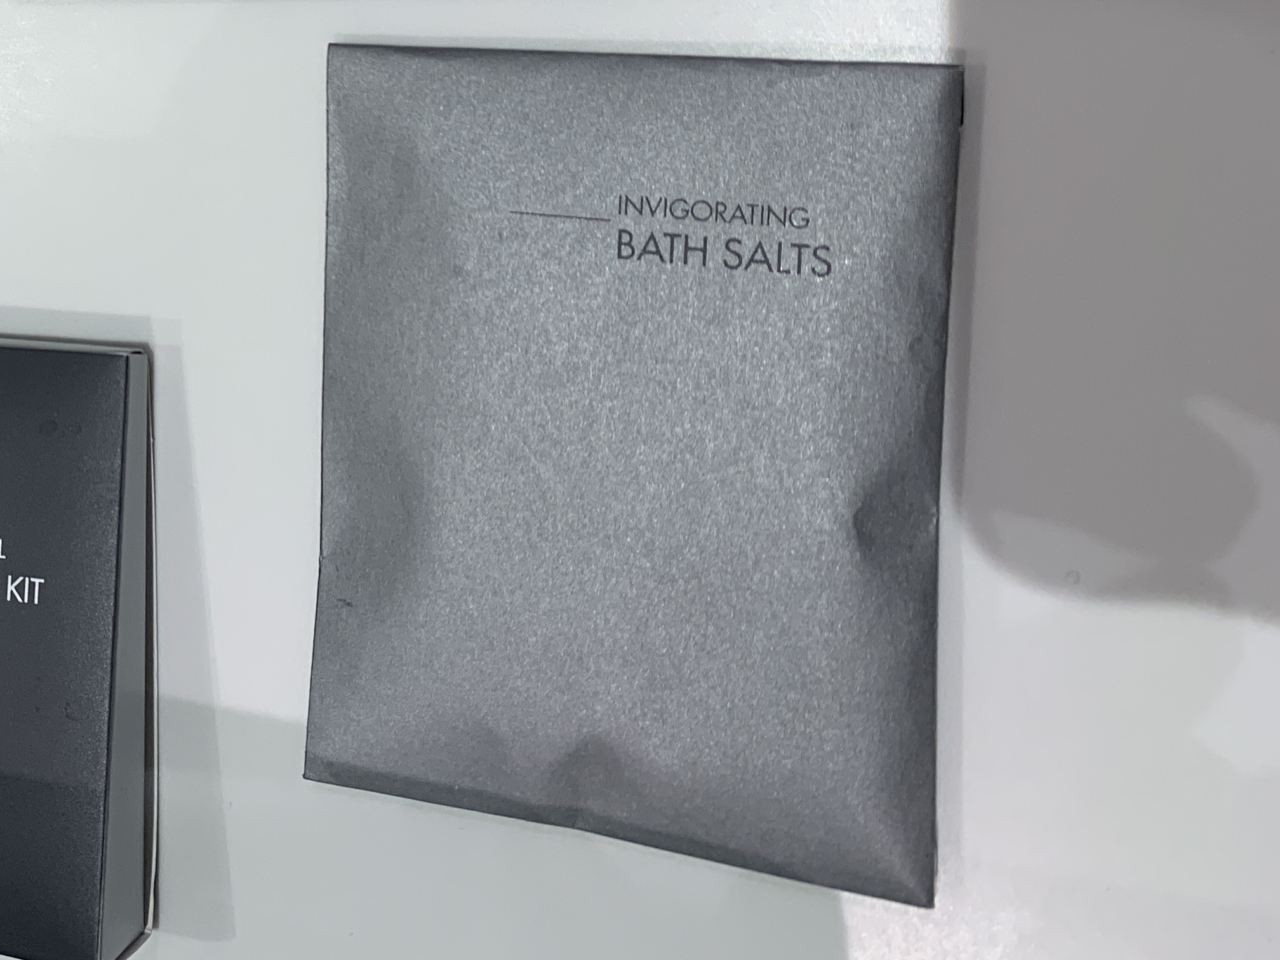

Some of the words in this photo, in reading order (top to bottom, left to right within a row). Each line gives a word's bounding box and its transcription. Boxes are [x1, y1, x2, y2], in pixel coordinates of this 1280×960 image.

[617, 194, 810, 230] INVIGORATING
[616, 228, 708, 267] BATH
[723, 237, 833, 278] SALTS
[6, 574, 45, 605] KIT
